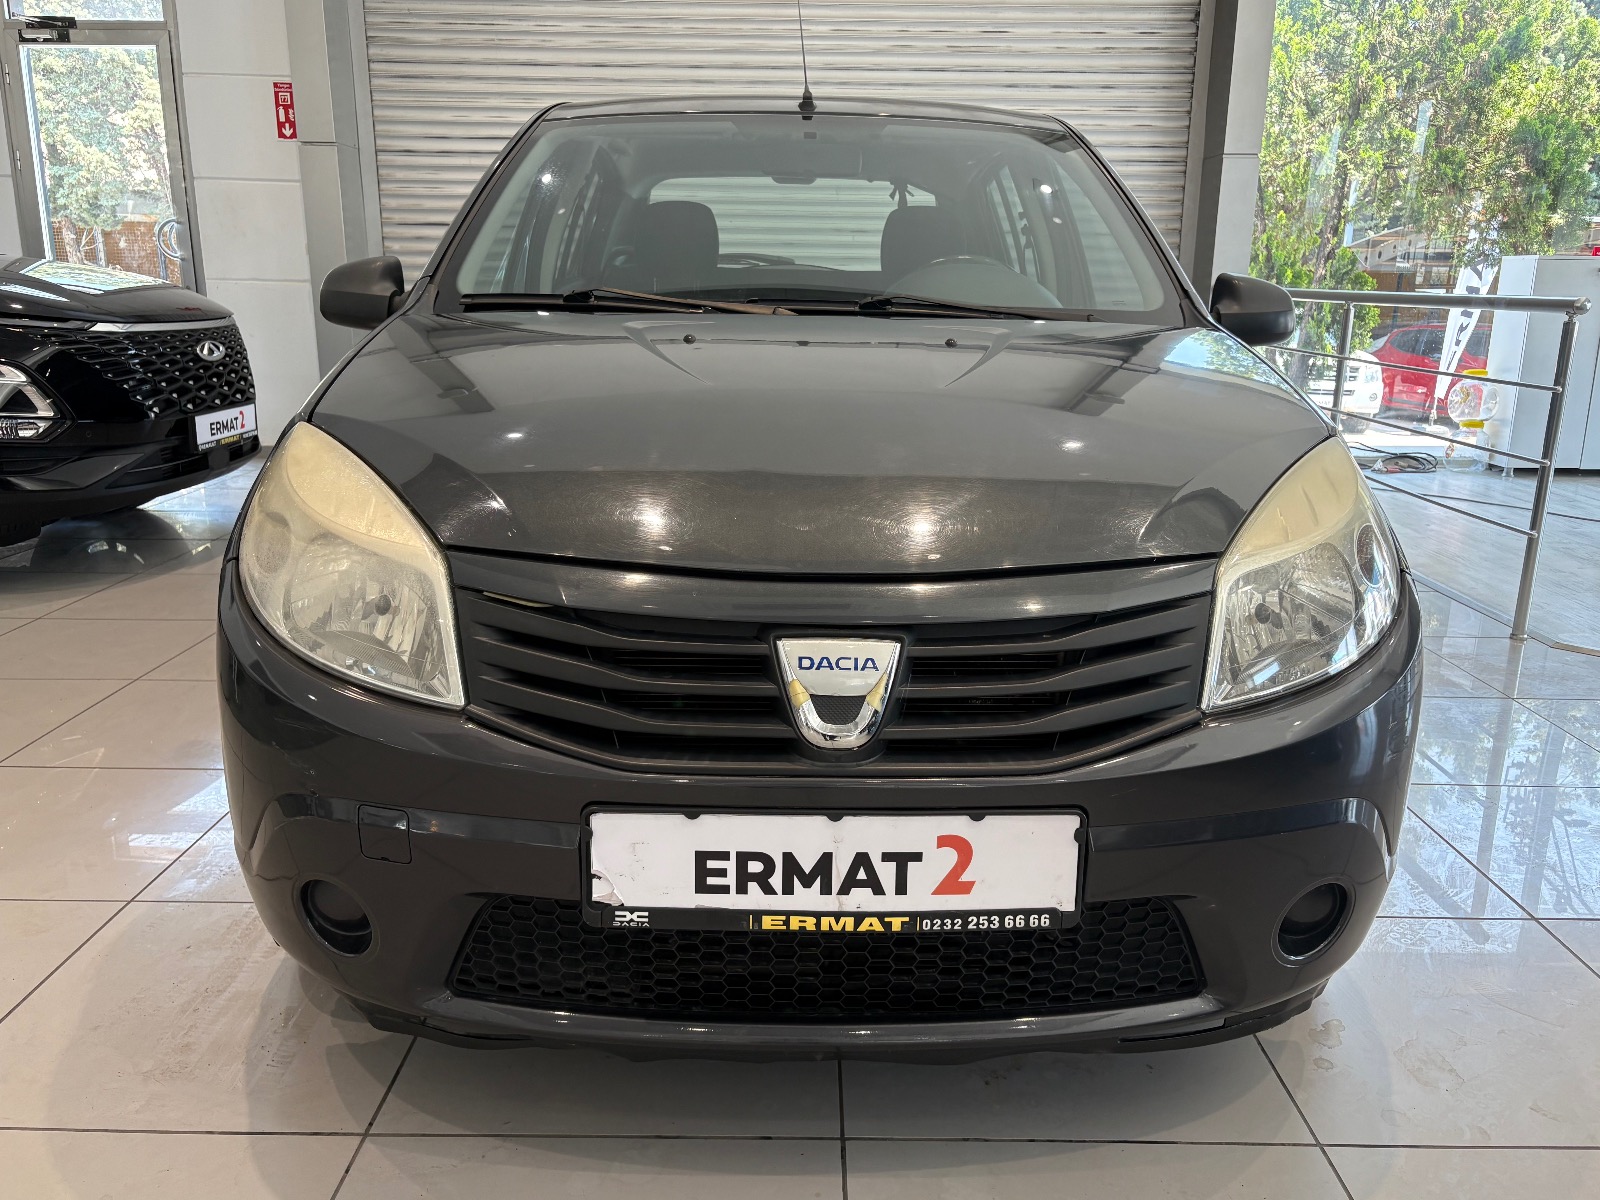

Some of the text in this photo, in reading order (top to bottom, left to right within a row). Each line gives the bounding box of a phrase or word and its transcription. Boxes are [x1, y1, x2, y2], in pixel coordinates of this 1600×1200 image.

[209, 416, 239, 437] ERMAT
[239, 410, 246, 429] 2
[797, 656, 880, 672] DACIA
[694, 834, 977, 896] ERMAT 2
[761, 914, 1051, 932] ERMAT 0232 253 66 66
